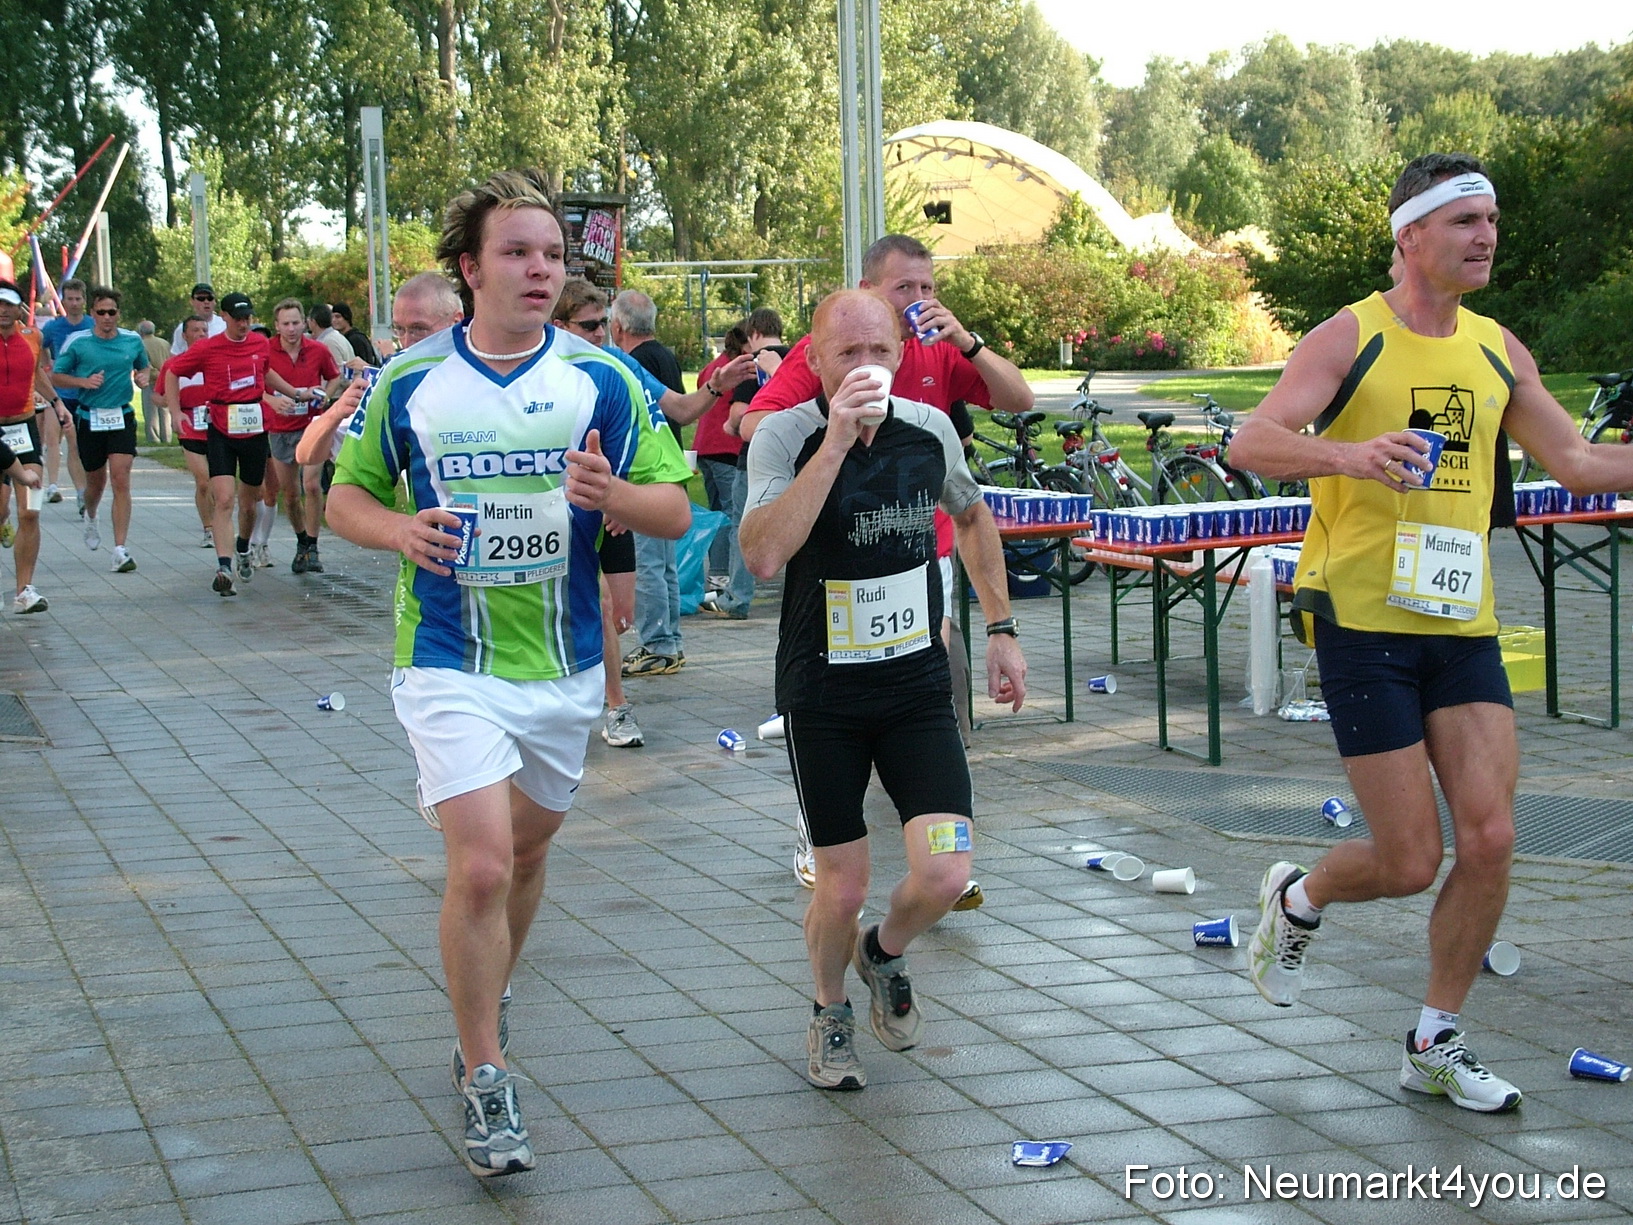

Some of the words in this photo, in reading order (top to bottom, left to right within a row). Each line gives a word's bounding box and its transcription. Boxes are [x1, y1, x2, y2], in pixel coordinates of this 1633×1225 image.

[100, 416, 121, 426] 3557
[242, 416, 258, 426] 300
[439, 431, 497, 444] TEAM
[438, 447, 568, 480] BOCK
[1435, 453, 1469, 470] SCH
[484, 502, 533, 520] Martin
[488, 531, 560, 561] 2986
[1425, 532, 1472, 556] Manfred
[527, 562, 567, 578] PFLEIDERER
[1398, 556, 1406, 569] B
[1431, 567, 1472, 594] 467
[856, 585, 886, 604] Rudi
[832, 611, 840, 624] B
[870, 607, 914, 638] 519
[895, 634, 929, 652] PFLEIDERER
